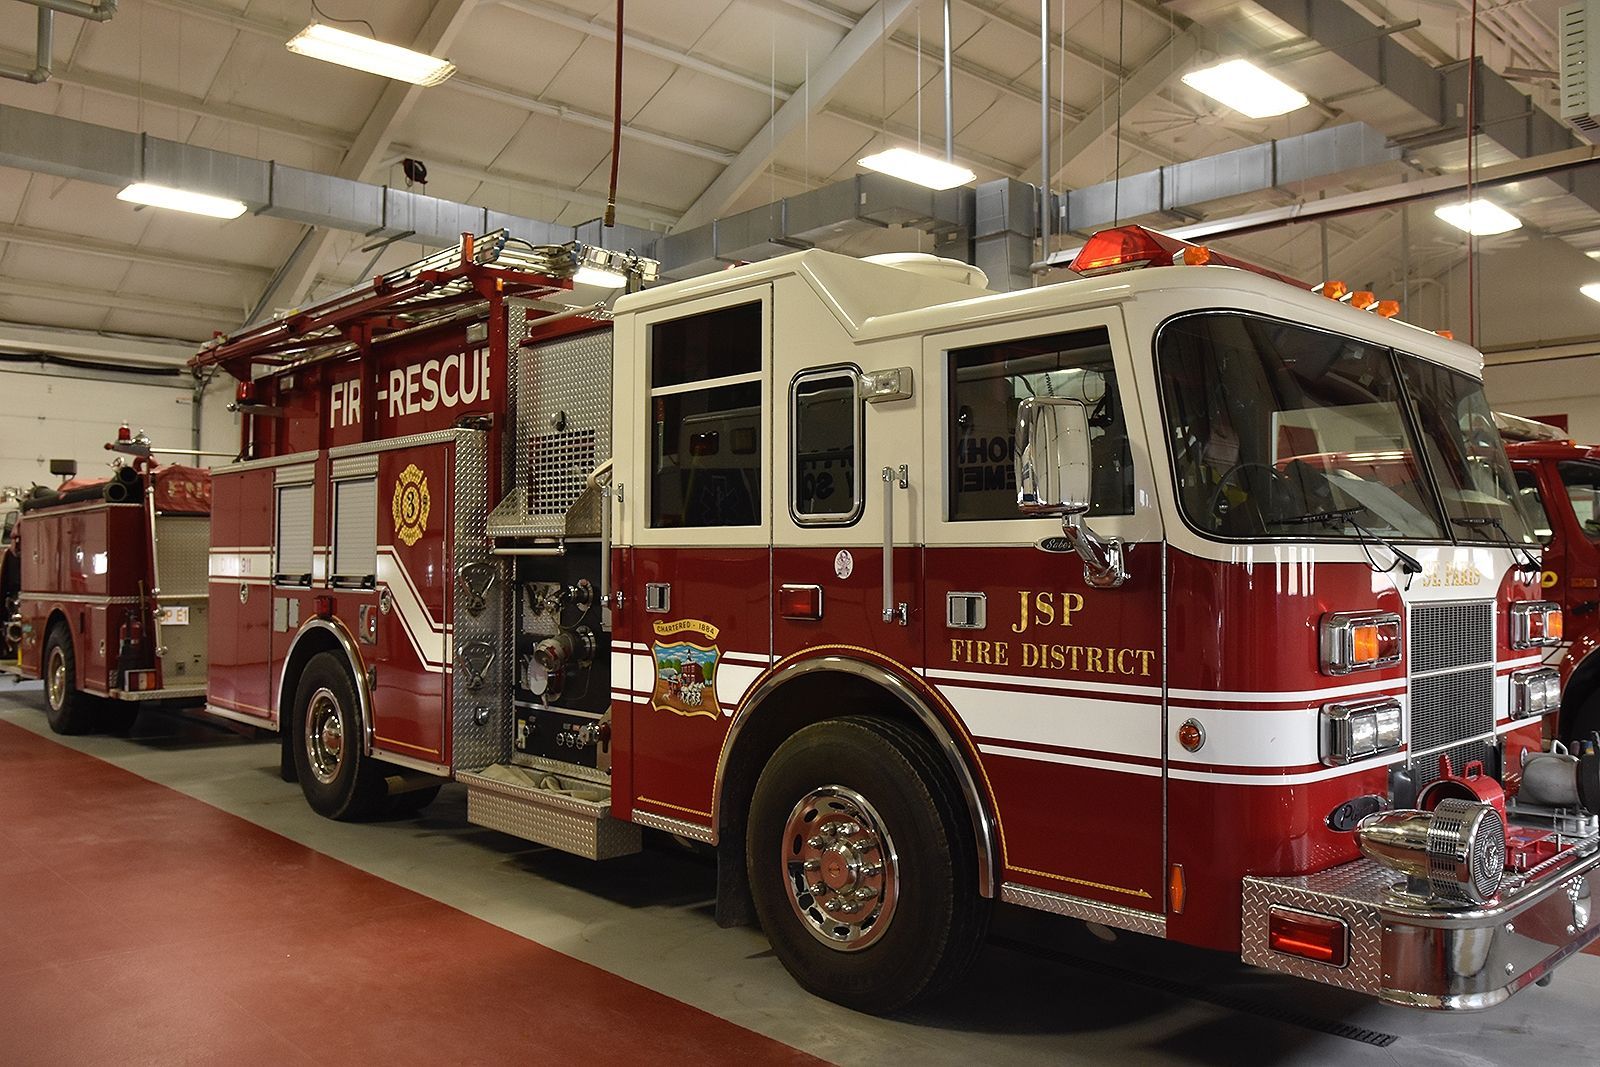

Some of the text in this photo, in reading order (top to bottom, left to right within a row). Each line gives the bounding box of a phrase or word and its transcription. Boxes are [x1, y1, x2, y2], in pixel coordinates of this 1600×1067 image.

[406, 491, 415, 519] 3
[1444, 560, 1481, 587] PARIS
[176, 608, 187, 622] E1
[1011, 590, 1086, 634] JSP
[657, 621, 691, 632] CHARTERED
[698, 623, 714, 635] 1884
[949, 637, 1157, 677] FIRE DISTRICT
